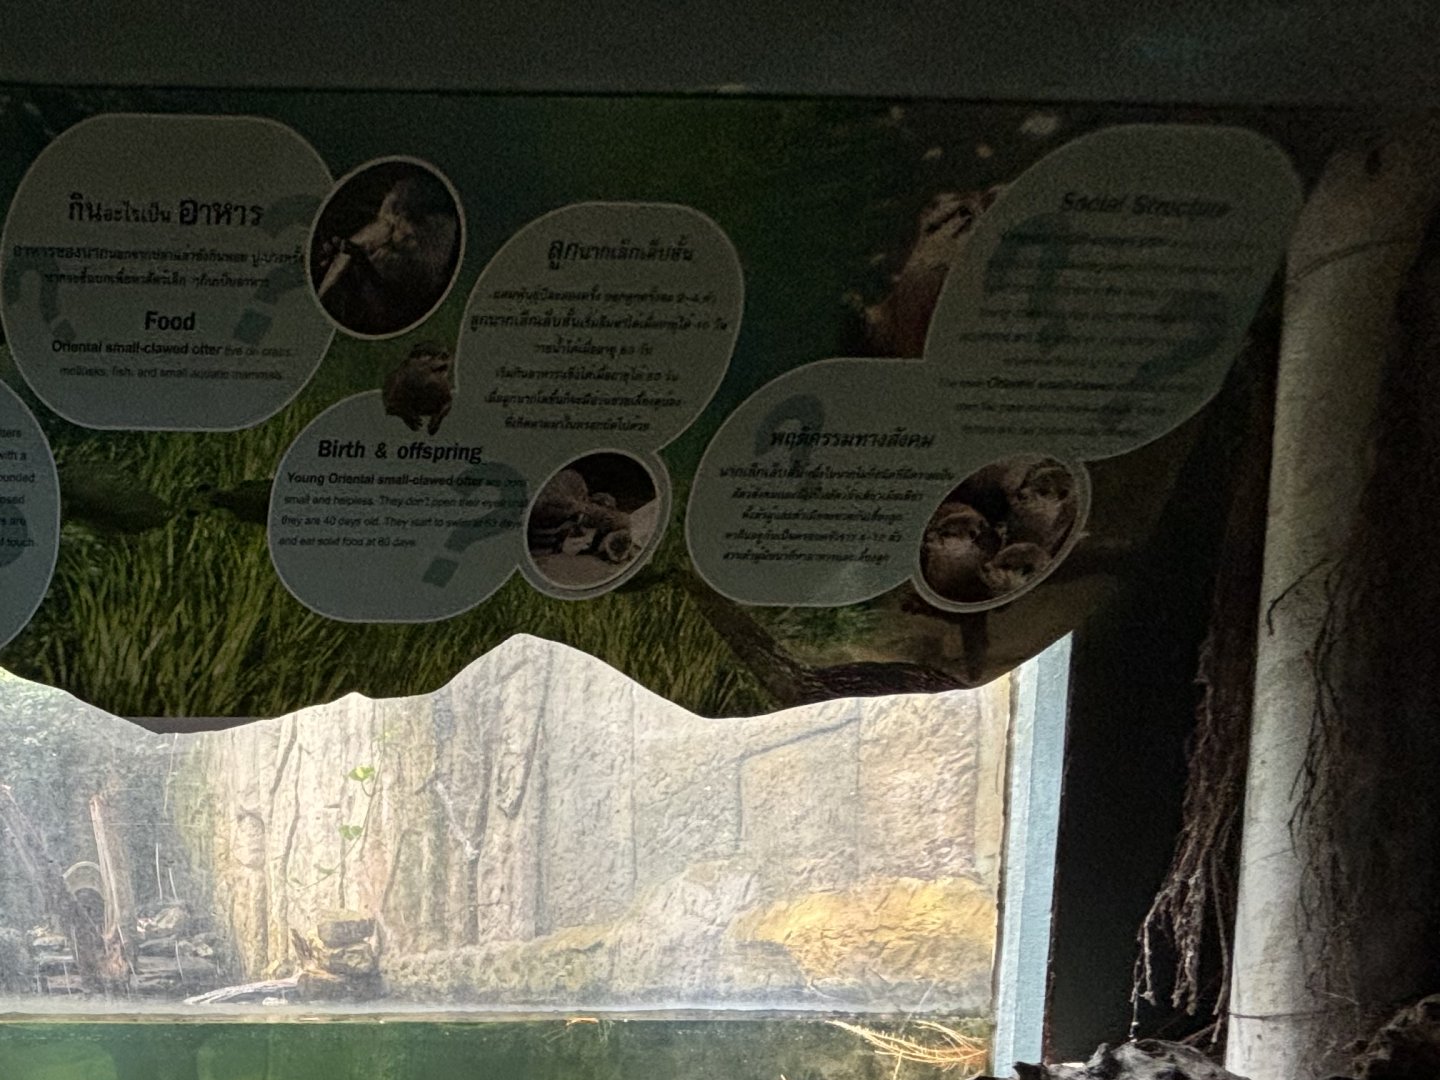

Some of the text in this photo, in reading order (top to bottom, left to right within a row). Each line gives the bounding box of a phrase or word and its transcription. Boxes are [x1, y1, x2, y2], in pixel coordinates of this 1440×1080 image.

[178, 198, 264, 227] อาหาร
[144, 310, 196, 331] Food
[51, 339, 103, 353] Oriental
[192, 343, 221, 356] otter
[318, 440, 484, 465] Birth & offspring
[287, 472, 325, 487] Young
[328, 472, 375, 485] Oriental
